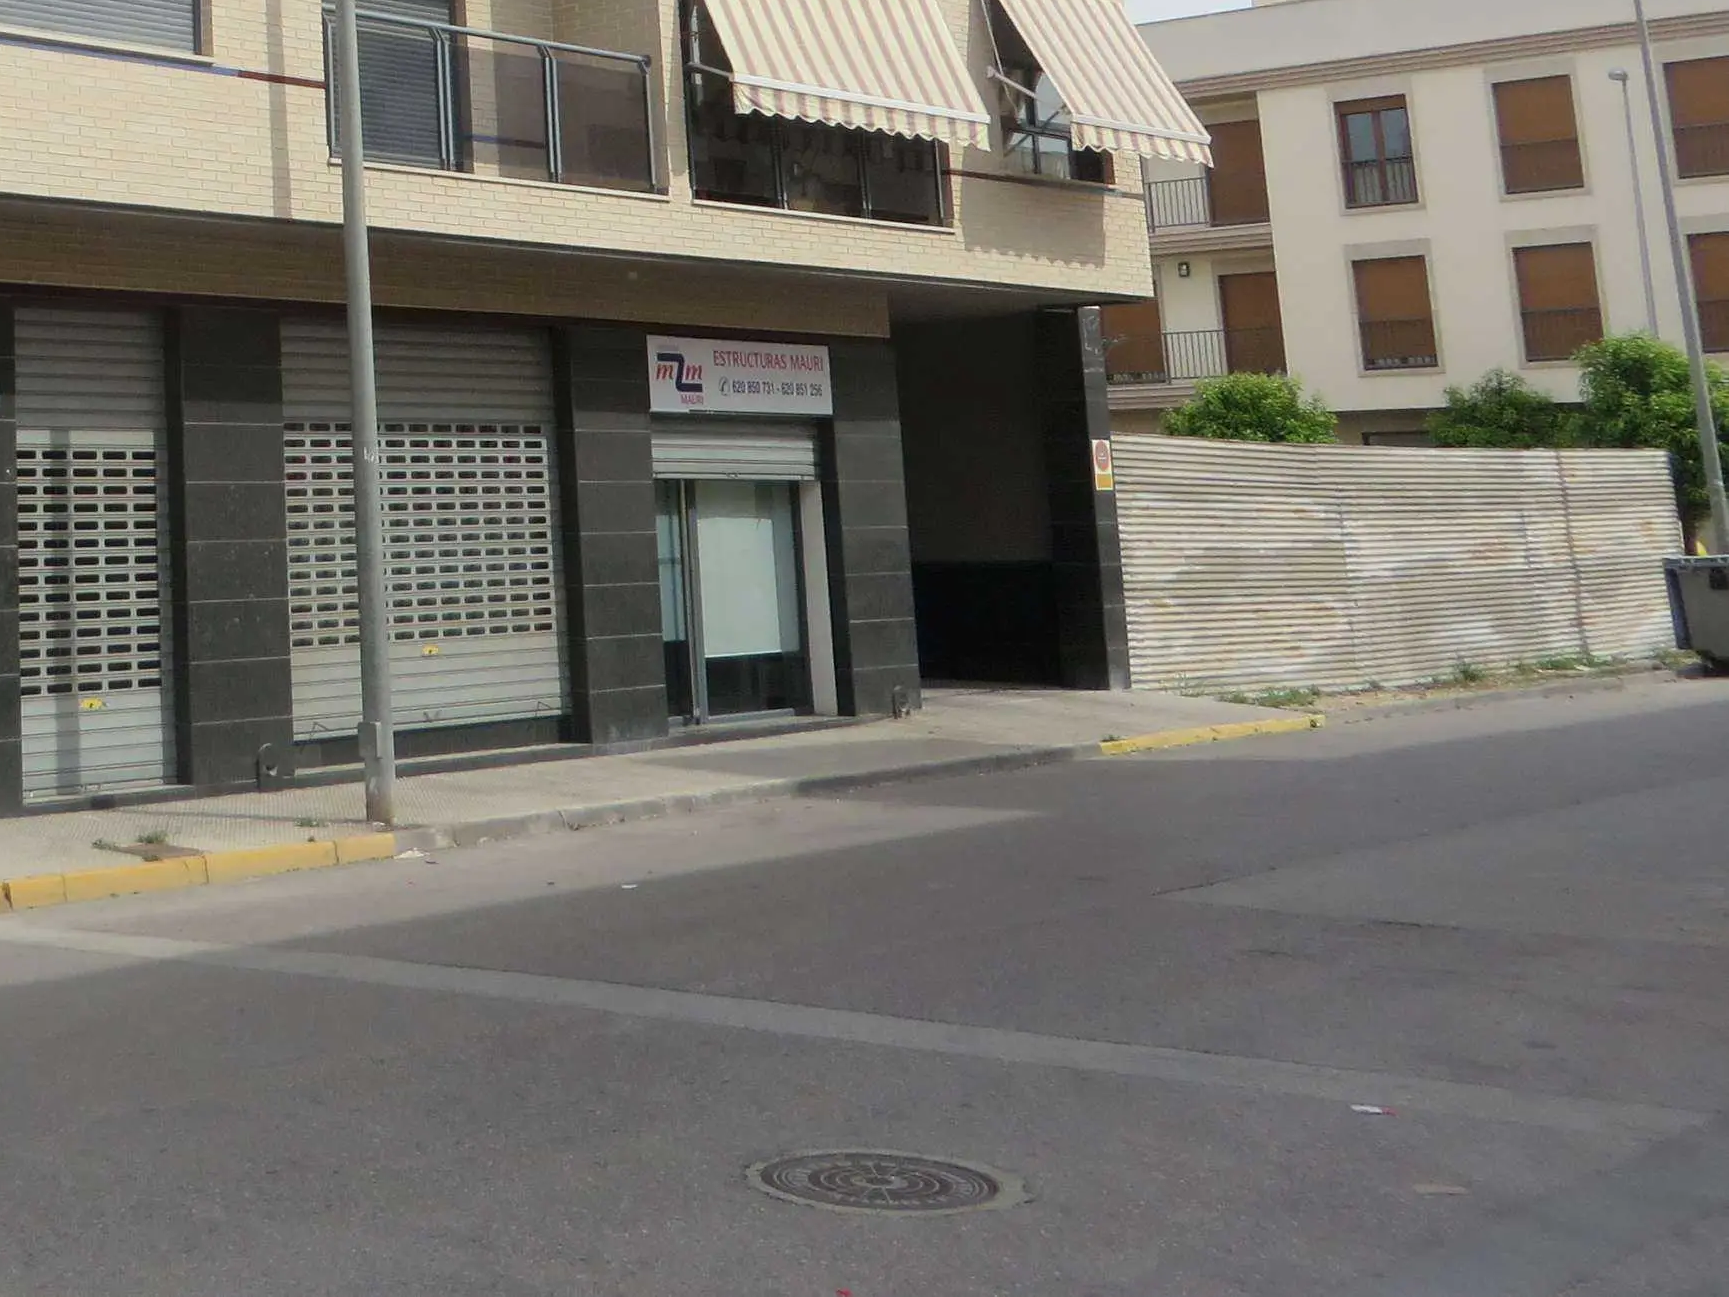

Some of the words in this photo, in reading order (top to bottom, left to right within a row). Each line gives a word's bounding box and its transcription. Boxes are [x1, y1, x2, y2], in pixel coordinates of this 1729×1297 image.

[713, 350, 787, 370] ESTRUCTURAS
[790, 354, 824, 372] MAURI
[732, 379, 746, 394] 620
[762, 381, 775, 395] 731
[680, 393, 704, 405] MAURI
